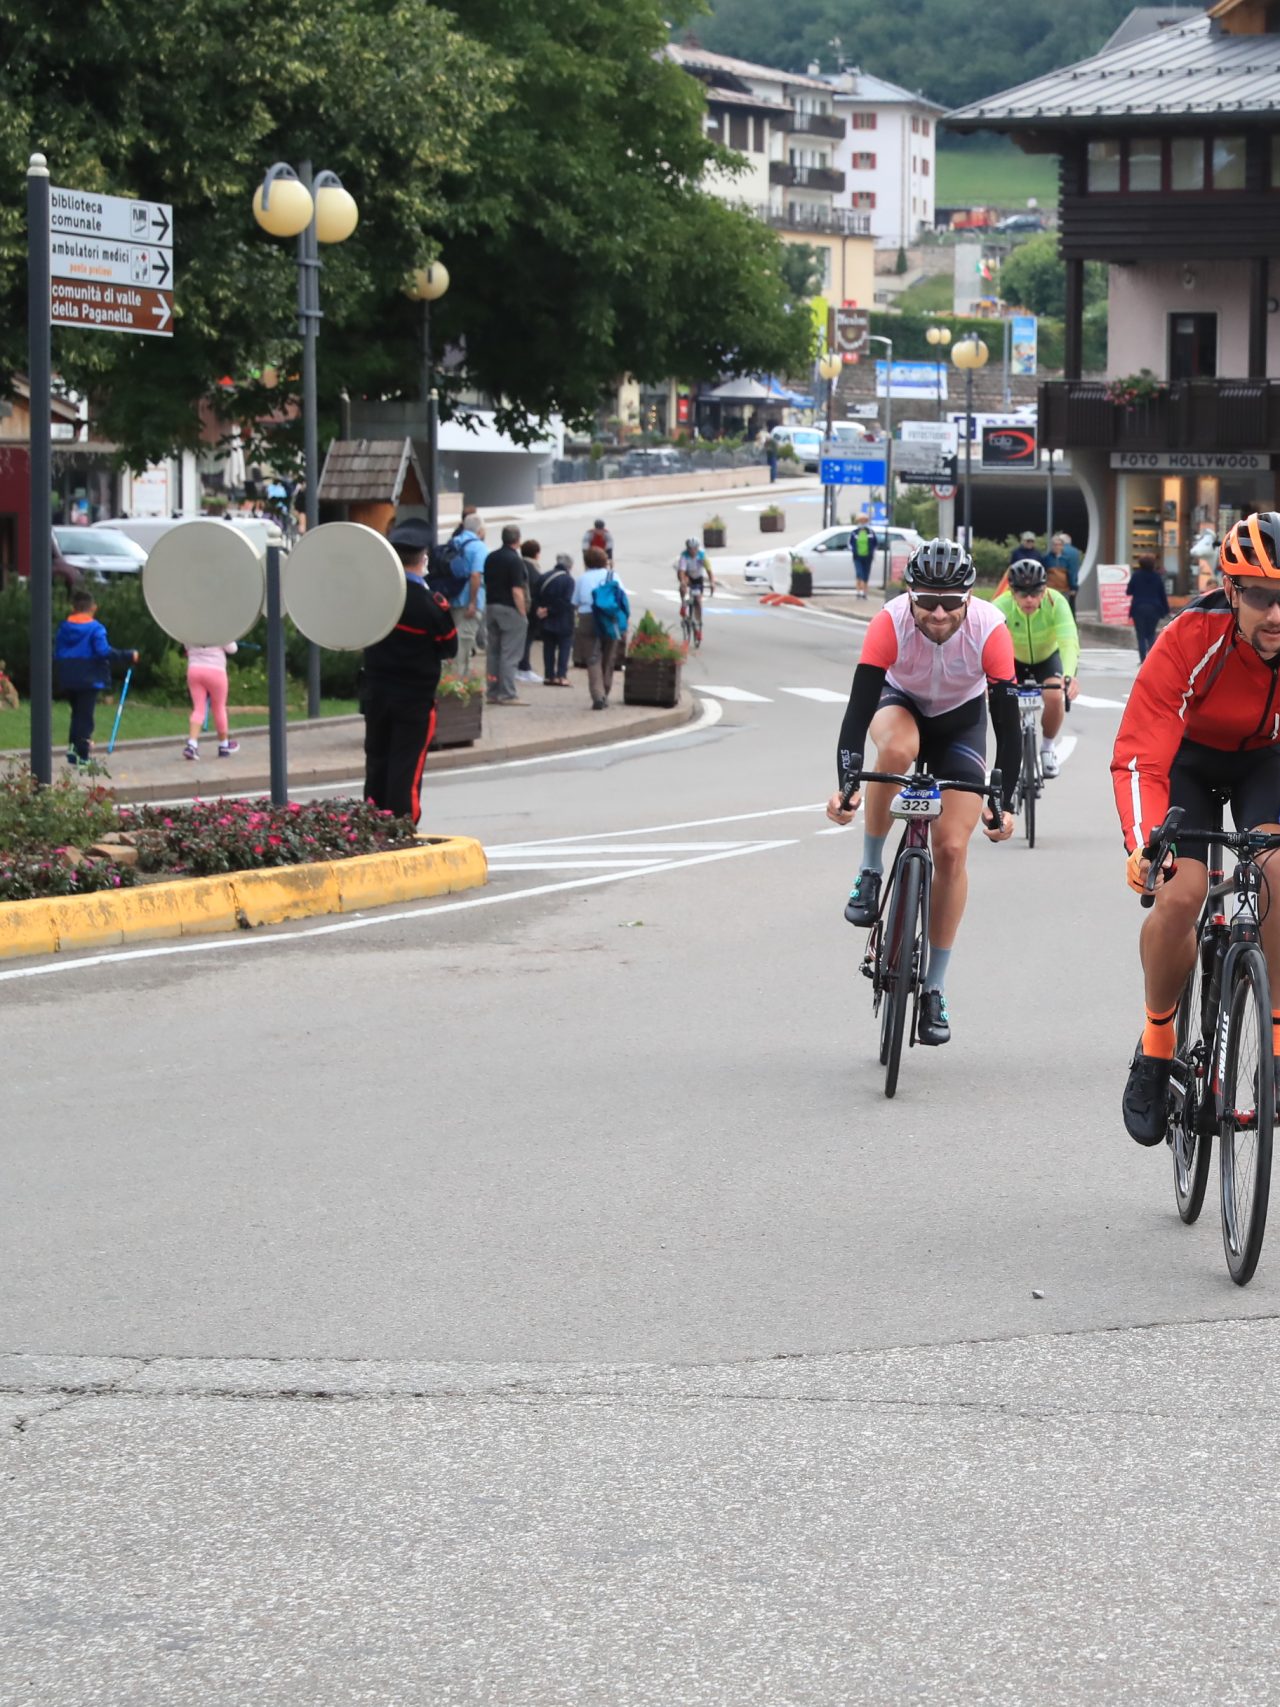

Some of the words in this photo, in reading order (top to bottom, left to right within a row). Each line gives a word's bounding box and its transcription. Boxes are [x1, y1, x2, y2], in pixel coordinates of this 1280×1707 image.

[51, 193, 103, 214] biblioteca
[51, 214, 102, 231] comunale
[52, 241, 99, 260] ambulatori
[102, 247, 130, 263] medici
[52, 284, 102, 302] comunità
[104, 288, 114, 303] di
[116, 290, 141, 306] valle
[52, 301, 79, 318] della
[82, 303, 133, 323] Paganella
[1120, 454, 1158, 466] FOTO
[1169, 454, 1259, 468] HOLLYWOOD
[901, 800, 930, 812] 323
[1218, 1010, 1230, 1083] STEVENS
